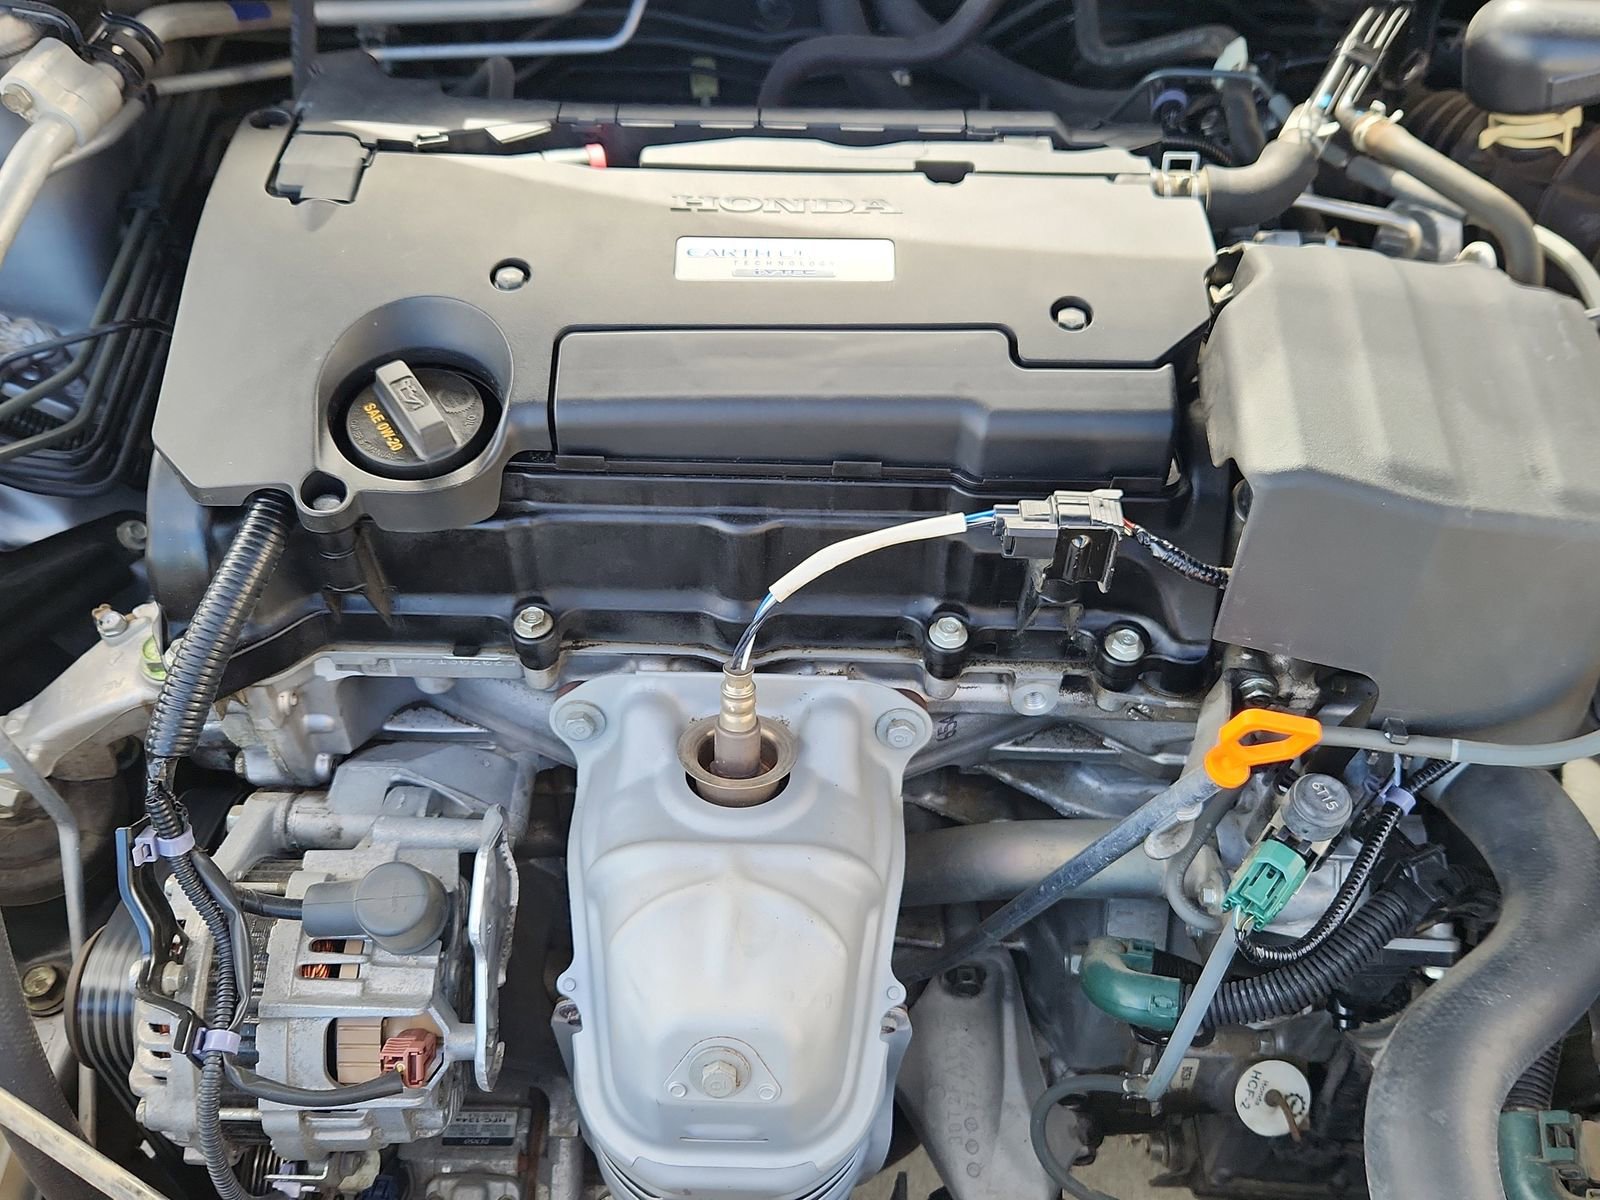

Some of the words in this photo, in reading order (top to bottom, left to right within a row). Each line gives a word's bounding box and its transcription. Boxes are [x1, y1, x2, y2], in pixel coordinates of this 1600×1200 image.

[670, 195, 903, 214] HONDA
[363, 402, 386, 424] SAE
[377, 422, 403, 451] 0W-20
[1312, 782, 1339, 810] 6T15
[1240, 1069, 1262, 1110] HCF-2
